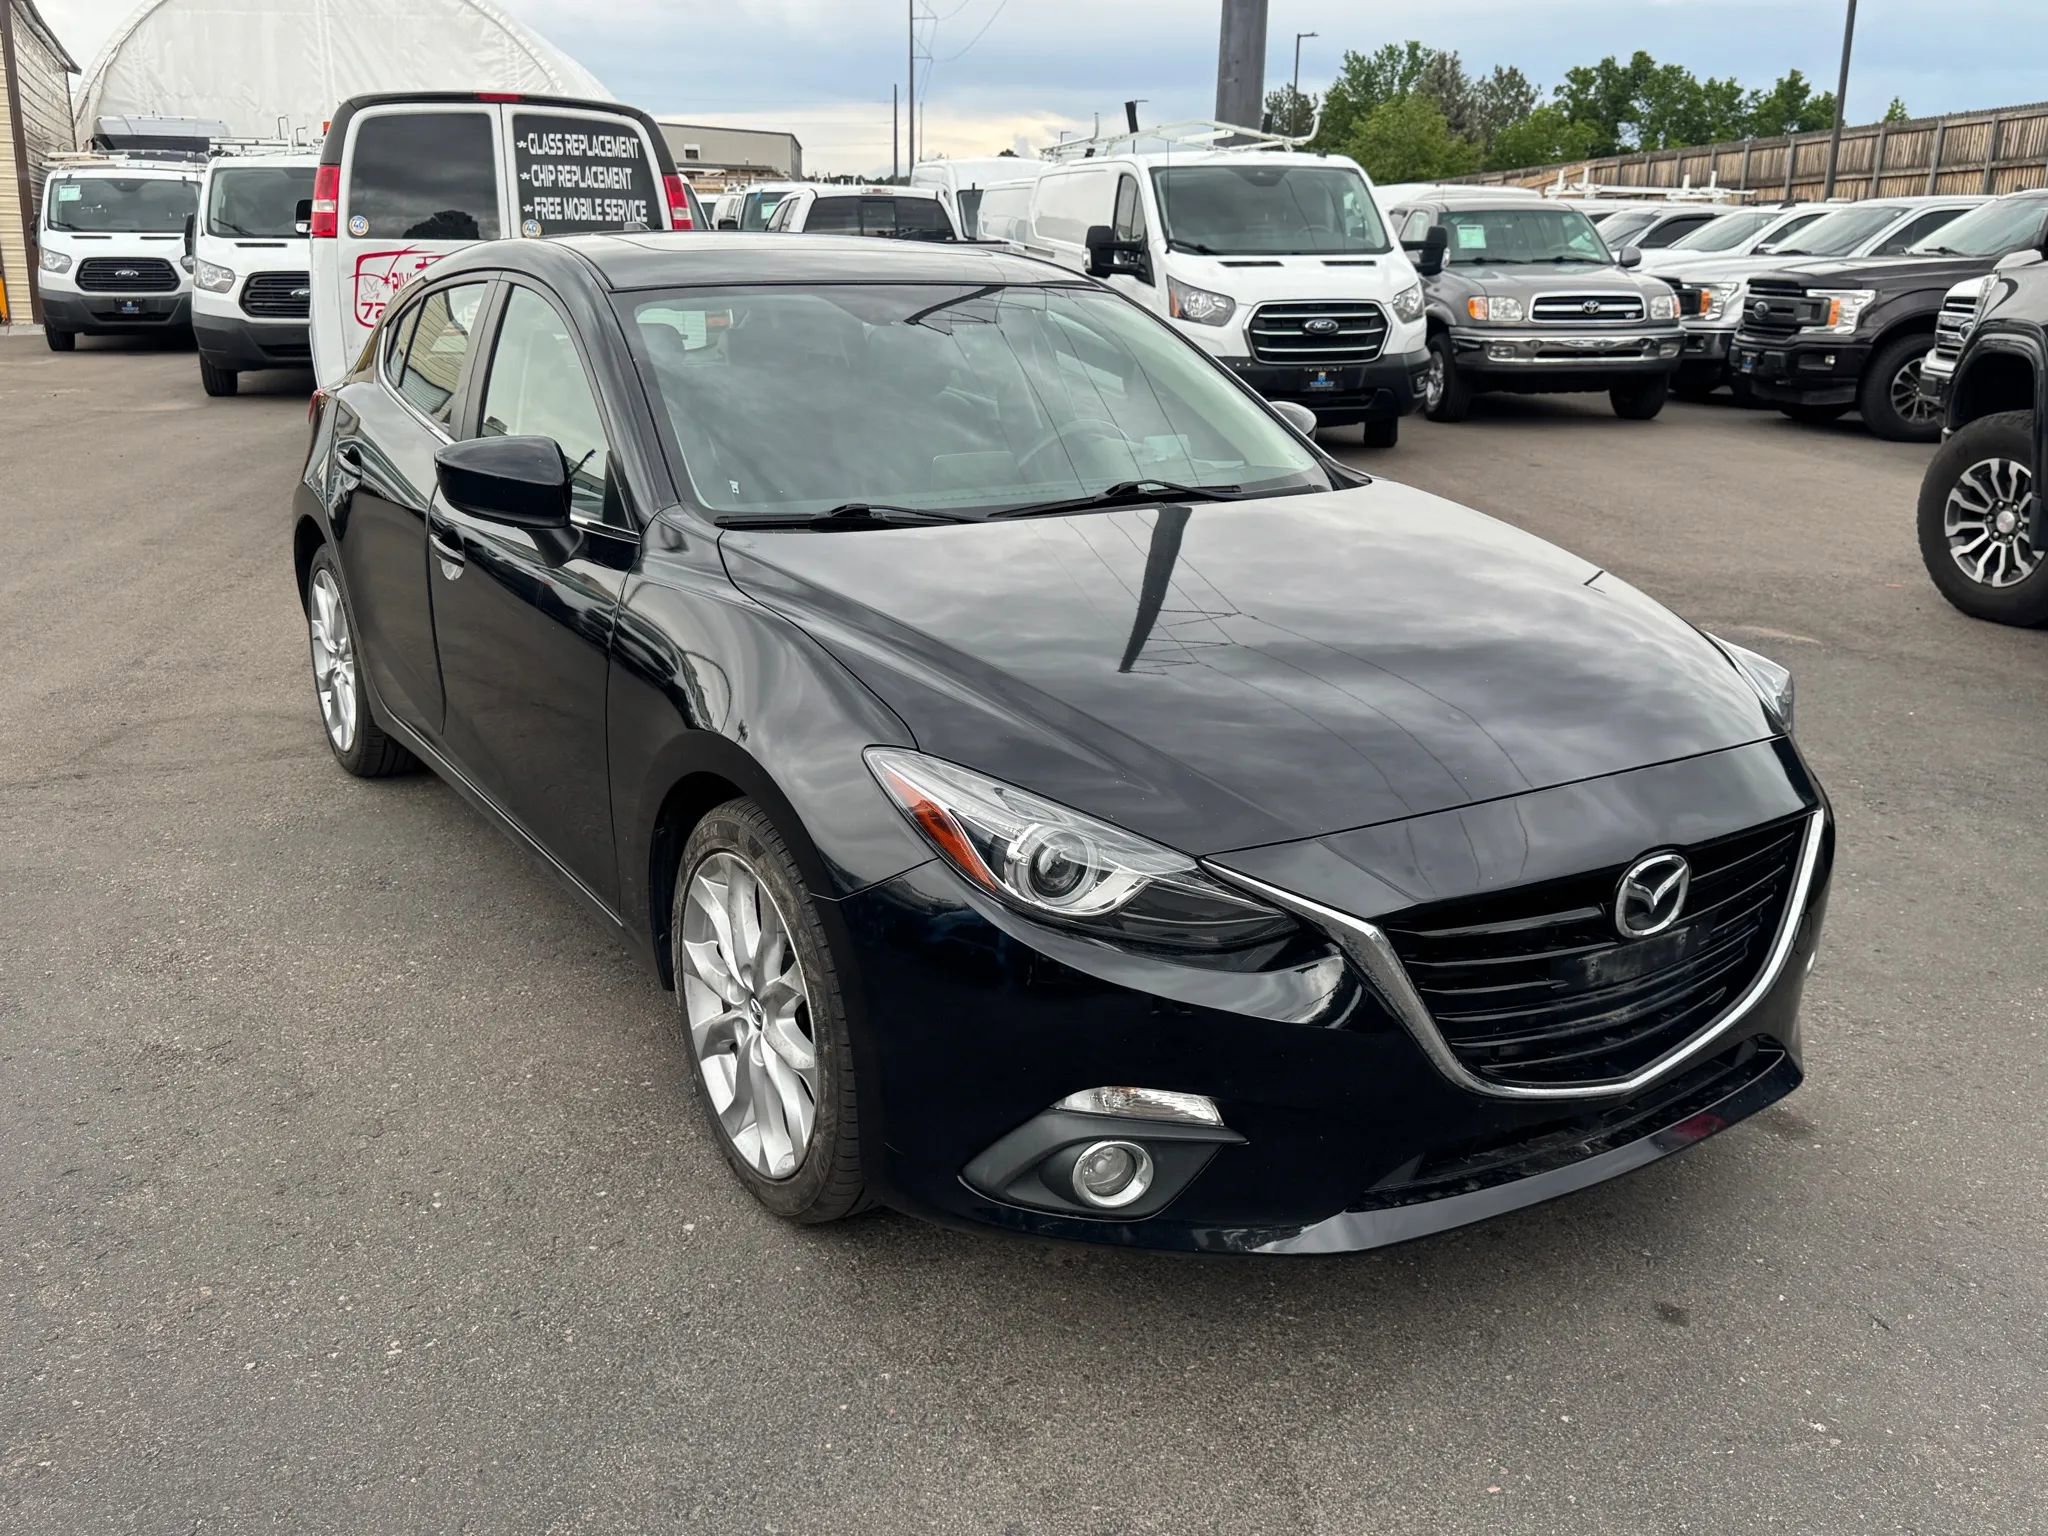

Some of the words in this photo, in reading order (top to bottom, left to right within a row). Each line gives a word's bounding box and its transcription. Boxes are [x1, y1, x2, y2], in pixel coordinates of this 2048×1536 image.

[528, 133, 563, 155] GLASS
[565, 134, 639, 159] REPLACEMENT
[531, 164, 556, 187] CHIP
[557, 165, 632, 190] REPLACEMENT
[533, 197, 563, 220] FREE
[563, 197, 602, 221] MOBILE
[604, 198, 648, 223] SERVICE
